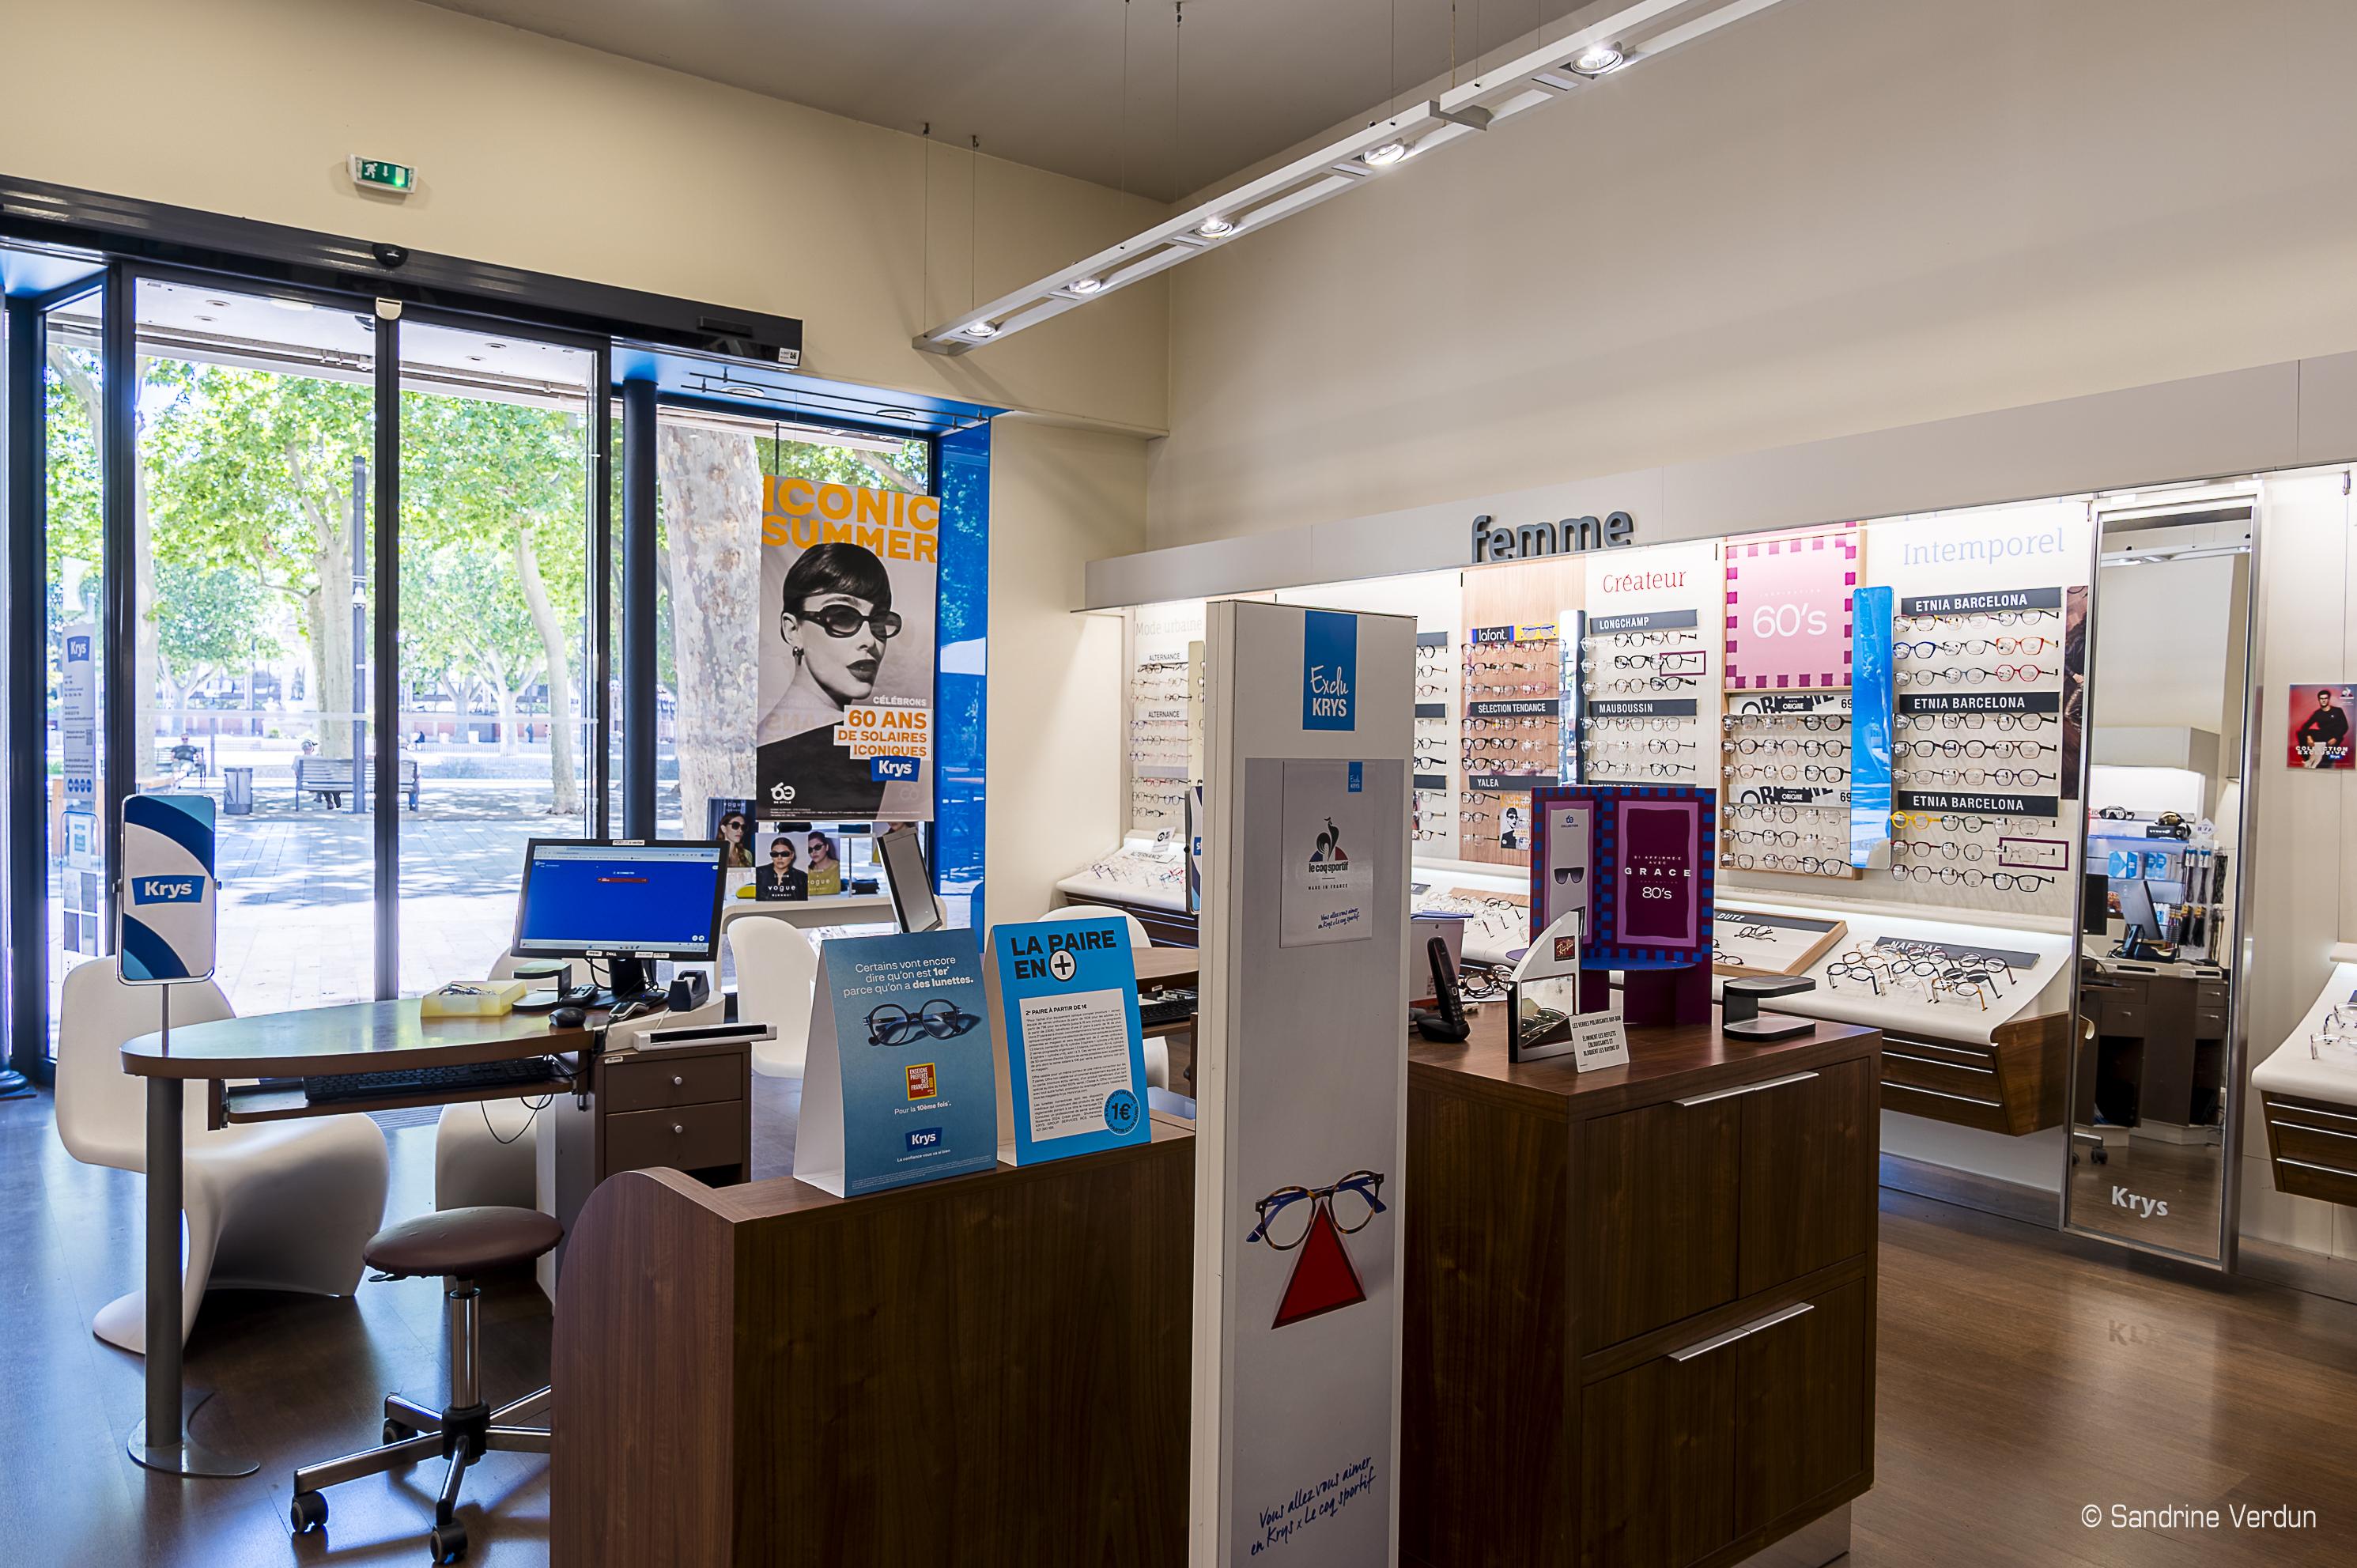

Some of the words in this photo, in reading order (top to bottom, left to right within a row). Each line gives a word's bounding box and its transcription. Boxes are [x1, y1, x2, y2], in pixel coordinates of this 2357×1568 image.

[763, 475, 939, 531] ICONIC
[762, 515, 938, 563] SUMMER
[1471, 511, 1634, 564] femme
[1904, 527, 2064, 565] Intemporel
[1603, 570, 1687, 593] Créateur
[1915, 599, 1951, 613] ETNIA
[1954, 594, 2027, 610] BARCELONA
[1600, 616, 1649, 630] LONGCHAMP
[1752, 603, 1827, 638] 60's
[70, 641, 86, 657] Krys
[1149, 653, 1180, 662] ALTERNANCE
[1310, 664, 1349, 696] Exclu
[873, 696, 927, 706] CÉLÉBRONS
[1313, 697, 1347, 717] KRYS
[1479, 703, 1511, 713] SÉLECTION
[1513, 703, 1546, 712] TENDANCE
[1599, 703, 1653, 713] MAUBOUSSIN
[1914, 698, 1948, 709] ETNIA
[1952, 697, 2025, 708] BARCELONA
[848, 710, 877, 727] 60
[882, 711, 927, 729] ANS
[838, 730, 857, 741] DE
[860, 731, 927, 743] SOLAIRES
[854, 745, 927, 757] ICONIQUES
[878, 760, 912, 776] Krys
[1477, 778, 1499, 788] YALEA
[1913, 795, 1947, 807] ETNIA
[1951, 797, 2024, 811] BARCELONA
[1309, 863, 1315, 873] le
[1315, 863, 1328, 874] coq
[1328, 861, 1349, 873] sportif
[1624, 867, 1691, 877] GRACE
[145, 881, 192, 899] Krys
[1642, 886, 1672, 899] 80's
[1717, 912, 1745, 921] DUTZ
[1011, 935, 1044, 957] LA
[1048, 929, 1117, 952] PAIRE
[1891, 940, 1914, 950] NAF
[1916, 943, 1942, 953] NAF
[855, 962, 898, 973] Certains
[900, 960, 921, 969] vont
[924, 956, 956, 966] encore
[1014, 958, 1047, 980] EN
[866, 973, 885, 983] dire
[887, 970, 915, 983] qu'on
[916, 969, 931, 977] est
[844, 986, 873, 998] parce
[875, 983, 902, 995] qu'on
[912, 980, 930, 989] des
[932, 977, 974, 987] lunettes.
[1590, 1017, 1609, 1026] POLARISANTS
[912, 1133, 936, 1145] Krys
[2111, 1185, 2169, 1219] Krys
[1260, 1504, 1284, 1528] Vous
[1287, 1488, 1316, 1513] allez
[1316, 1472, 1339, 1498] vous
[1342, 1457, 1372, 1481] aimer
[1251, 1541, 1264, 1555] en
[1267, 1521, 1294, 1547] Krys
[1305, 1506, 1316, 1524] Le
[1319, 1498, 1339, 1517] coq
[1338, 1465, 1377, 1506] sportif
